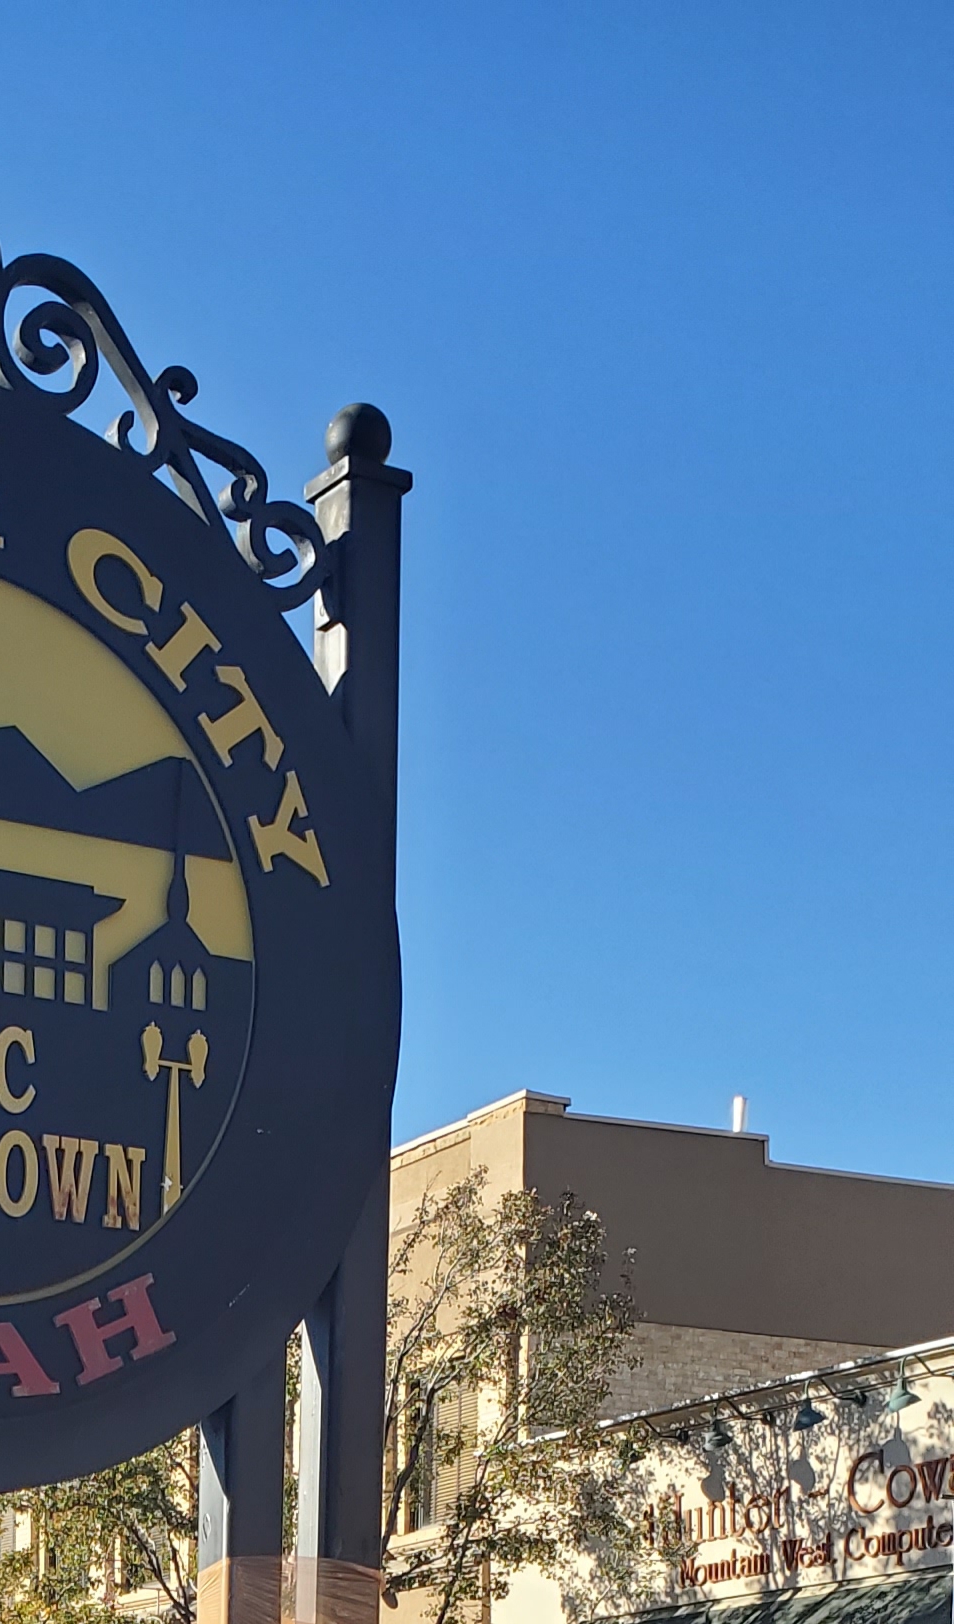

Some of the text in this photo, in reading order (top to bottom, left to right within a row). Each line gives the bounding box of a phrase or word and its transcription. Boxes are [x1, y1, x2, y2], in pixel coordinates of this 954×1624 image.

[64, 527, 330, 888] CITY
[847, 1448, 954, 1514] Cow
[678, 1547, 771, 1588] Mountain
